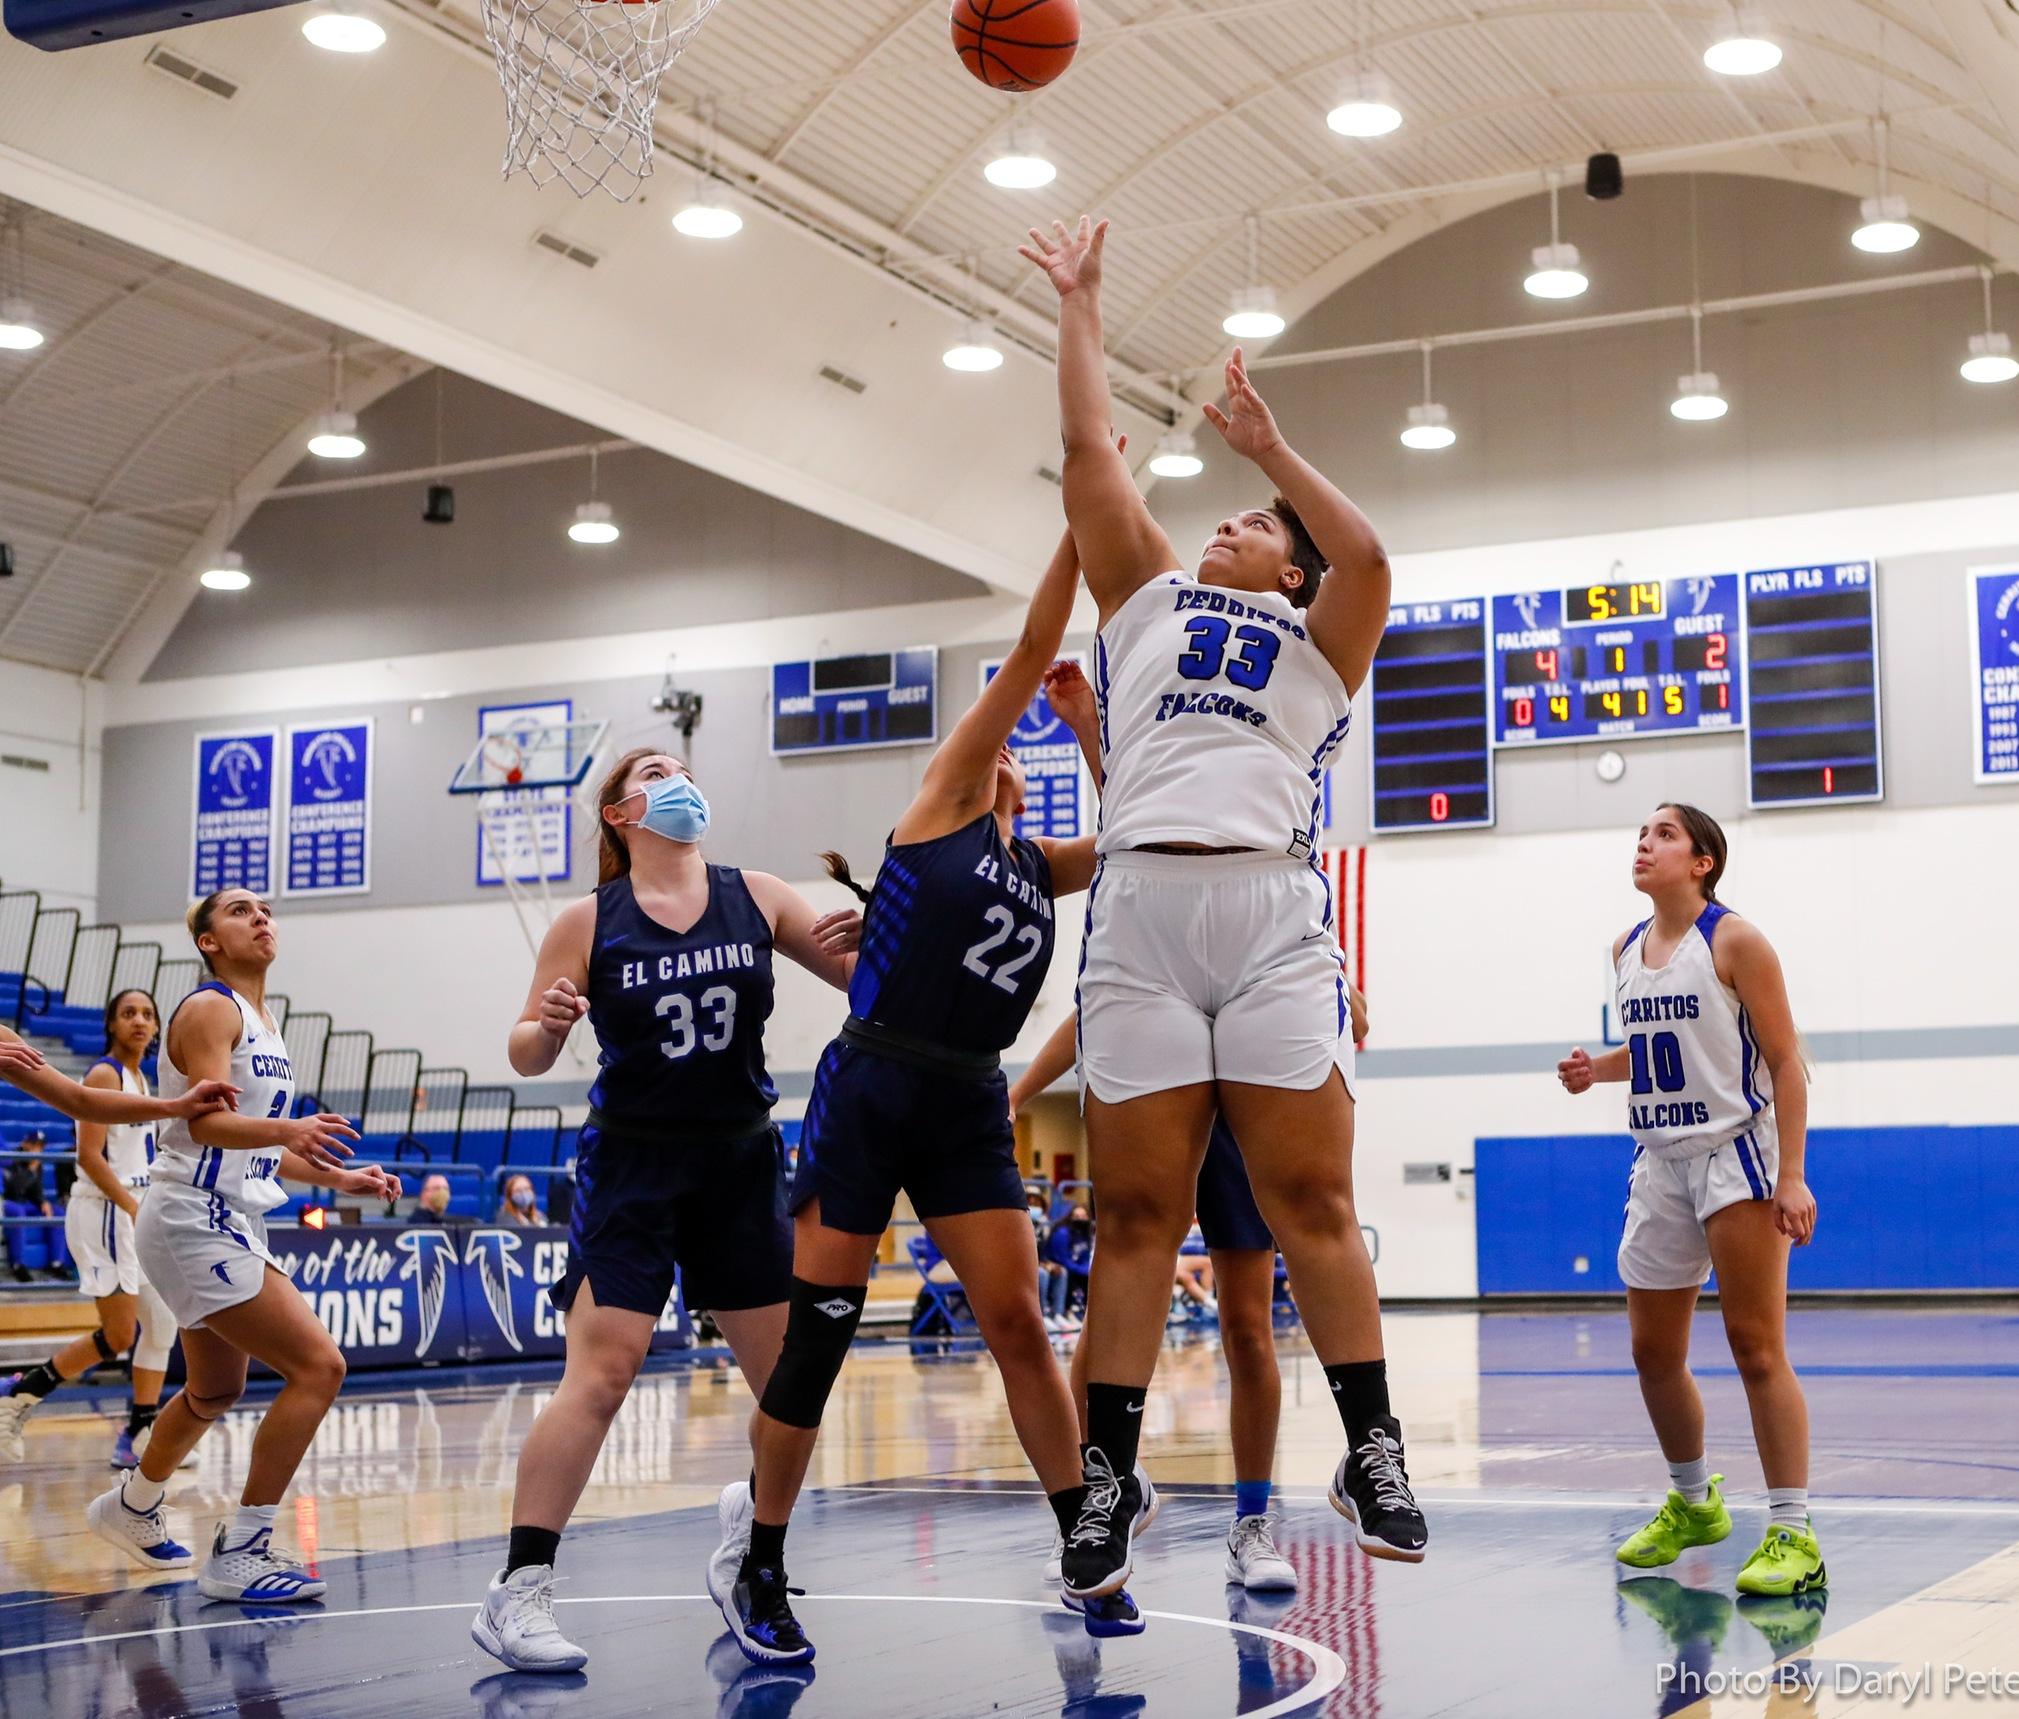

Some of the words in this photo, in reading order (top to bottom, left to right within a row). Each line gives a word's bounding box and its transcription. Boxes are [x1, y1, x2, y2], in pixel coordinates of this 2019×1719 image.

[1750, 572, 1789, 593] PLYR
[1794, 568, 1823, 589] FLS
[1835, 565, 1866, 586] PTS
[1413, 604, 1442, 623] FLS
[1451, 602, 1480, 621] PTS
[1587, 582, 1662, 620] 5:14
[1496, 628, 1561, 650] FALCONS
[1674, 613, 1725, 635] GUEST
[1177, 615, 1282, 692] 33
[1536, 650, 1557, 681] 4
[1614, 647, 1625, 673] 1
[1706, 633, 1727, 669] 2
[1514, 697, 1533, 727] 0
[1550, 696, 1569, 721] 4
[1664, 685, 1683, 715] 5
[1718, 684, 1728, 710] 1
[1824, 767, 1833, 793] 1
[1431, 792, 1449, 821] 0
[974, 854, 1000, 884] EL
[962, 904, 1043, 994] 22
[623, 962, 648, 989] EL
[658, 943, 755, 981] CAMINO
[655, 985, 737, 1059] 33
[1629, 1031, 1686, 1095] 10
[1629, 1101, 1710, 1130] ALCONS
[303, 1238, 343, 1286] of
[344, 1237, 397, 1285] the
